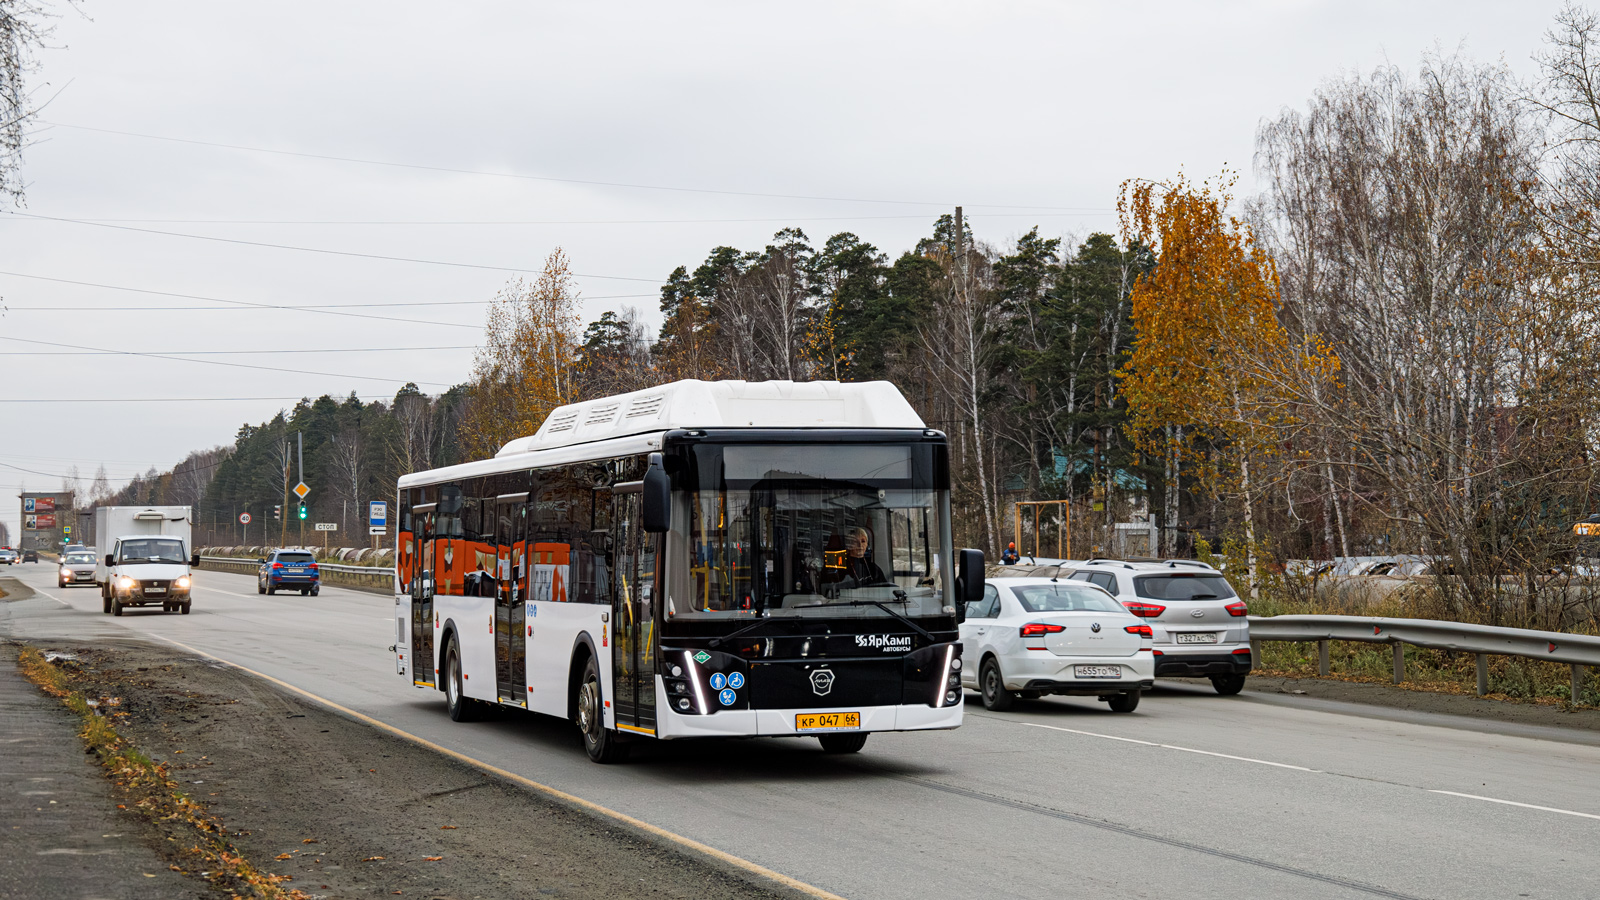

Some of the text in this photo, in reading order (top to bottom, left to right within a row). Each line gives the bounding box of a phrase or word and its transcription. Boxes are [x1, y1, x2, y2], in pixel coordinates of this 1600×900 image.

[868, 634, 911, 648] ЯрКамп
[819, 715, 839, 726] 047
[845, 714, 856, 722] 66
